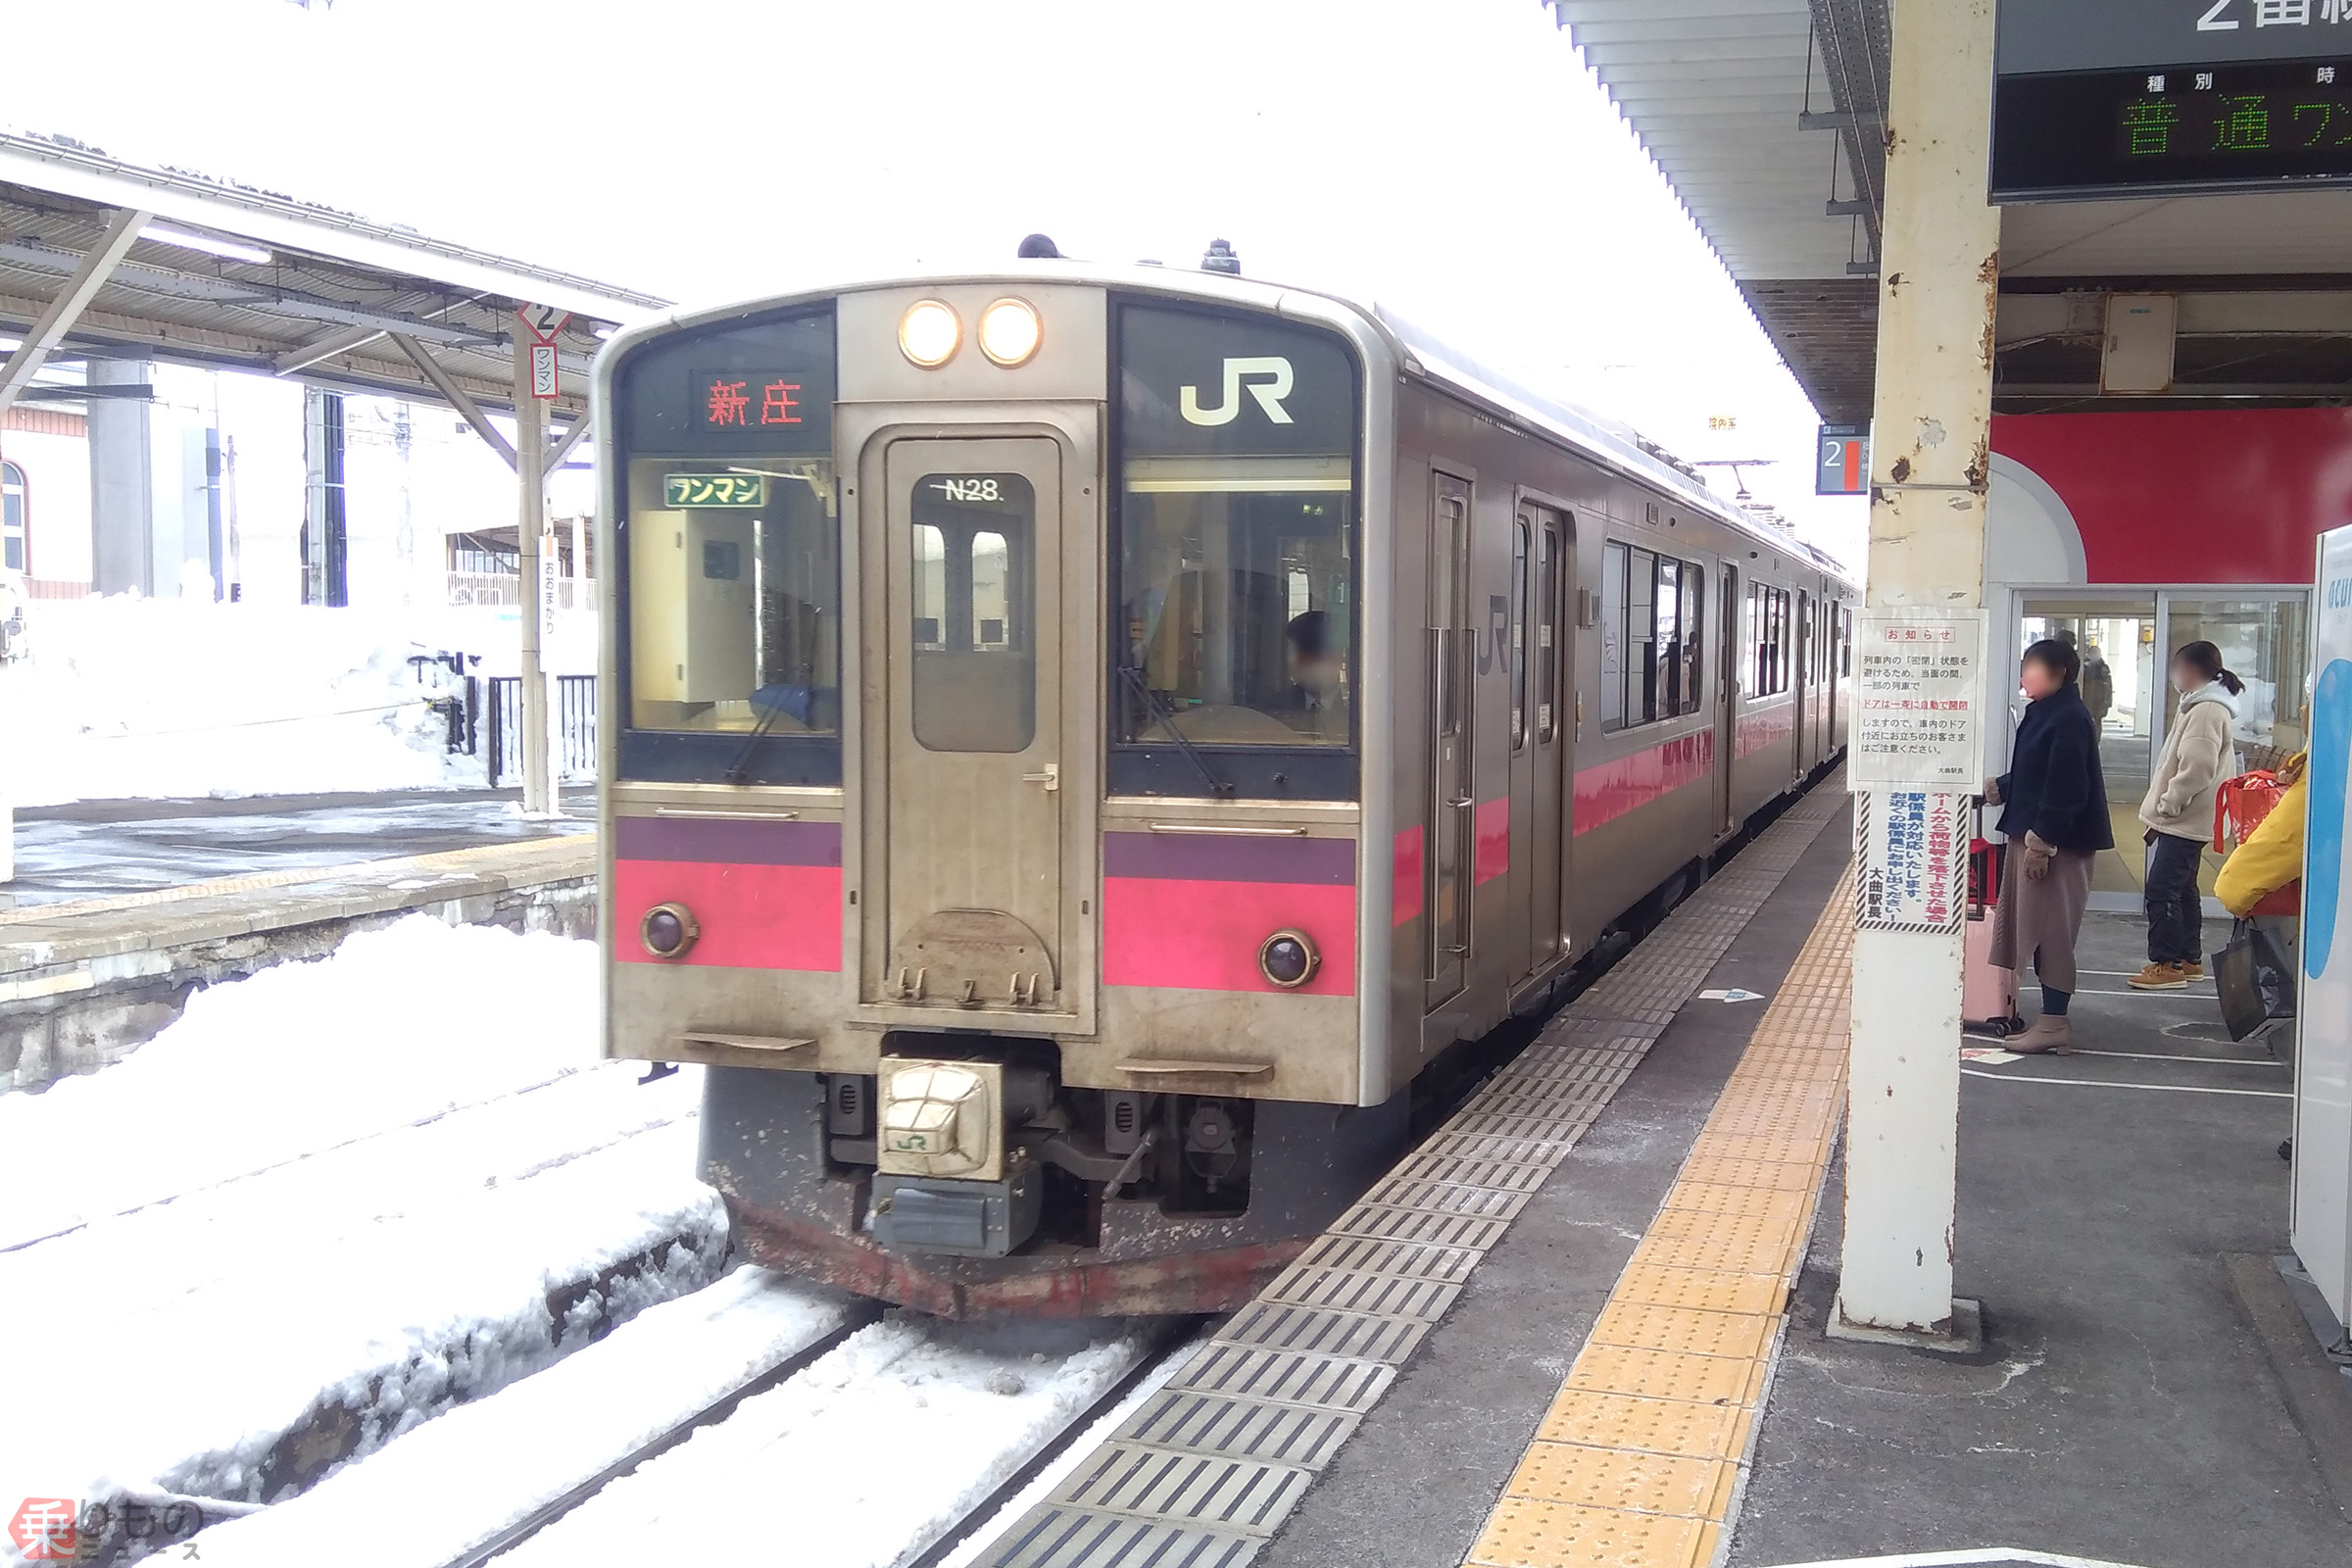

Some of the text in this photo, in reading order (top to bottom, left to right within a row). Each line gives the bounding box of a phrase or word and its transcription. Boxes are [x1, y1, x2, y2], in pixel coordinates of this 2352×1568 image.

[2146, 67, 2335, 93] 種別 時
[536, 304, 556, 330] 2
[537, 348, 552, 393] ワンマン
[708, 379, 802, 425] 新庄
[1180, 356, 1295, 426] JR
[1824, 441, 1841, 466] 2
[668, 477, 760, 504] ワンマン
[1478, 594, 1509, 676] JR
[1887, 629, 1951, 640] お知らせ
[1863, 681, 1920, 691] 一部の列車で
[1863, 700, 1969, 710] ドアは一斉に自動で開閉
[1861, 731, 1967, 742] 付近にお立ちのお客さま
[1863, 718, 1967, 729] しますので、車内のドア
[1861, 744, 1942, 755] はご注意ください。
[1904, 792, 1927, 903] 駅係員が対応いたします。
[1867, 866, 1884, 919] 大曲駅長
[897, 1135, 927, 1151] JR
